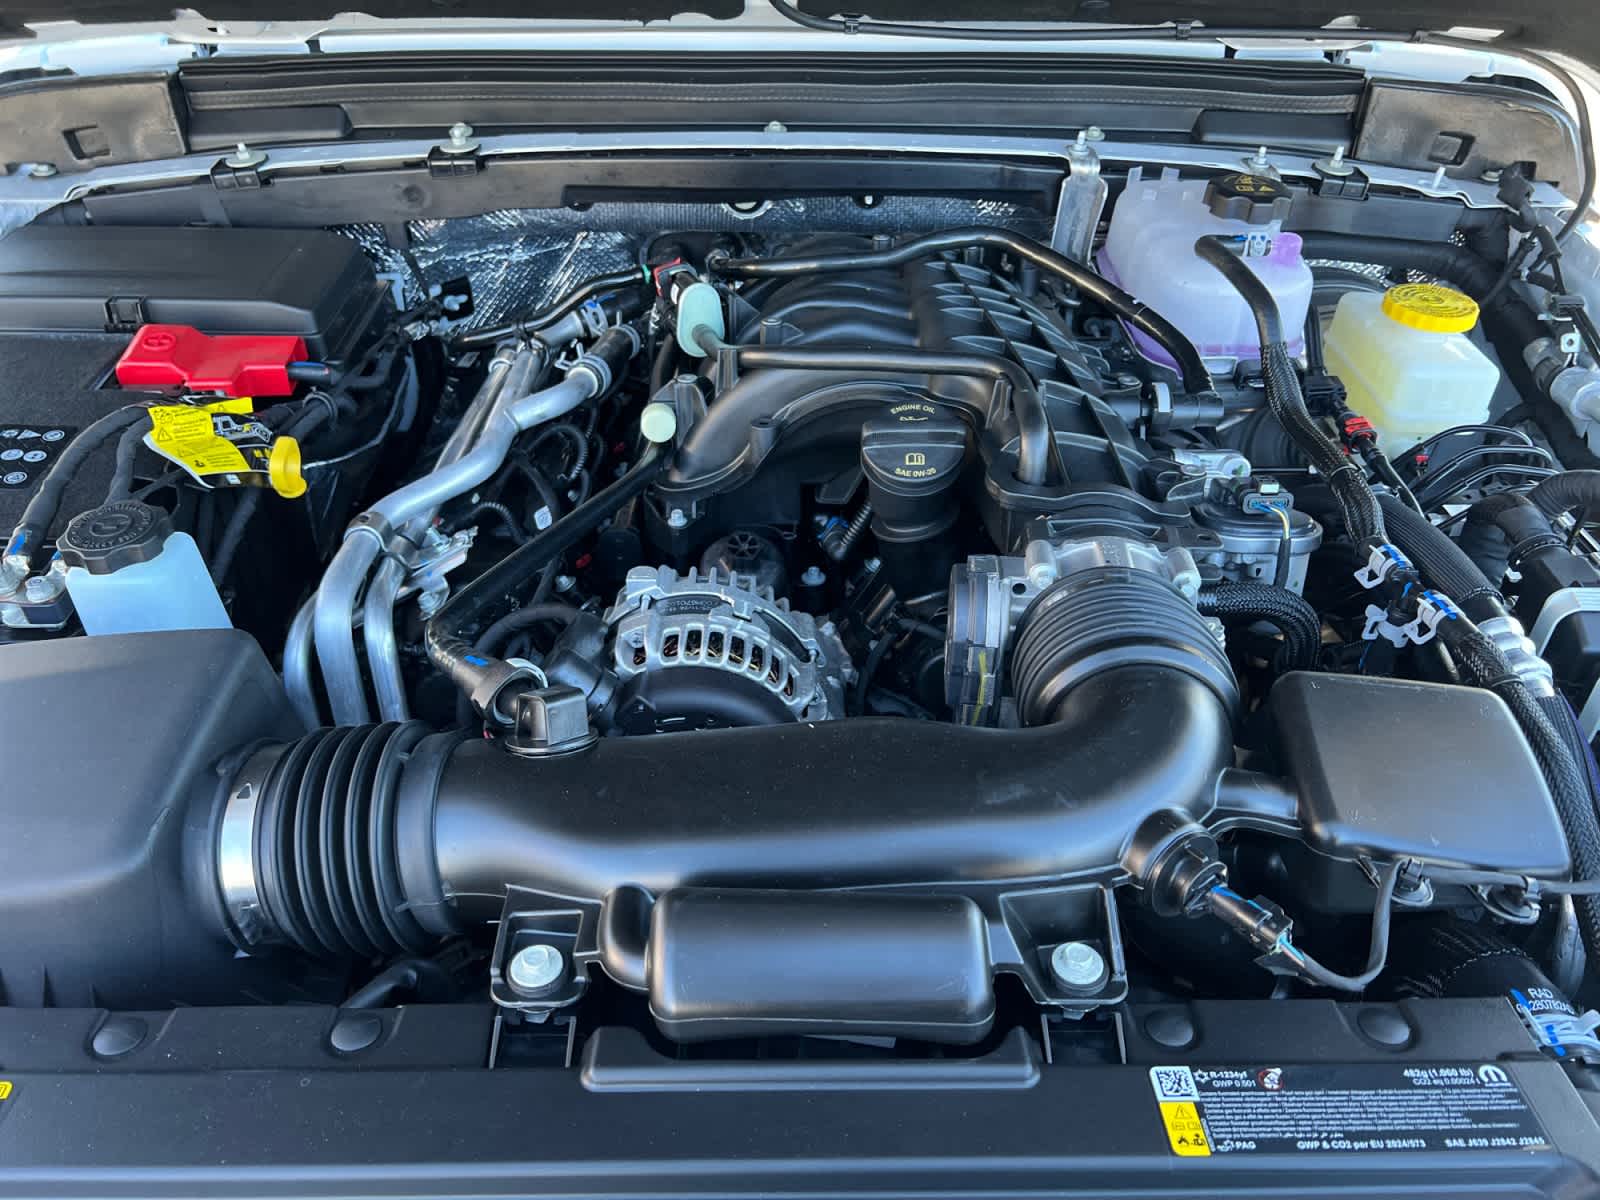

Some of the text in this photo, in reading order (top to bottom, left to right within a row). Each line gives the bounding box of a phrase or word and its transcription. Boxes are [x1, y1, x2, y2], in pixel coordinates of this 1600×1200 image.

[890, 404, 935, 414] ENGINE OIL
[895, 468, 912, 477] SAE
[1528, 988, 1553, 999] RAD
[1235, 1140, 1257, 1150] PAG
[1296, 1140, 1320, 1150] GWP
[1331, 1139, 1352, 1149] CO2
[1369, 1139, 1384, 1149] EU
[1444, 1138, 1465, 1147] SAE
